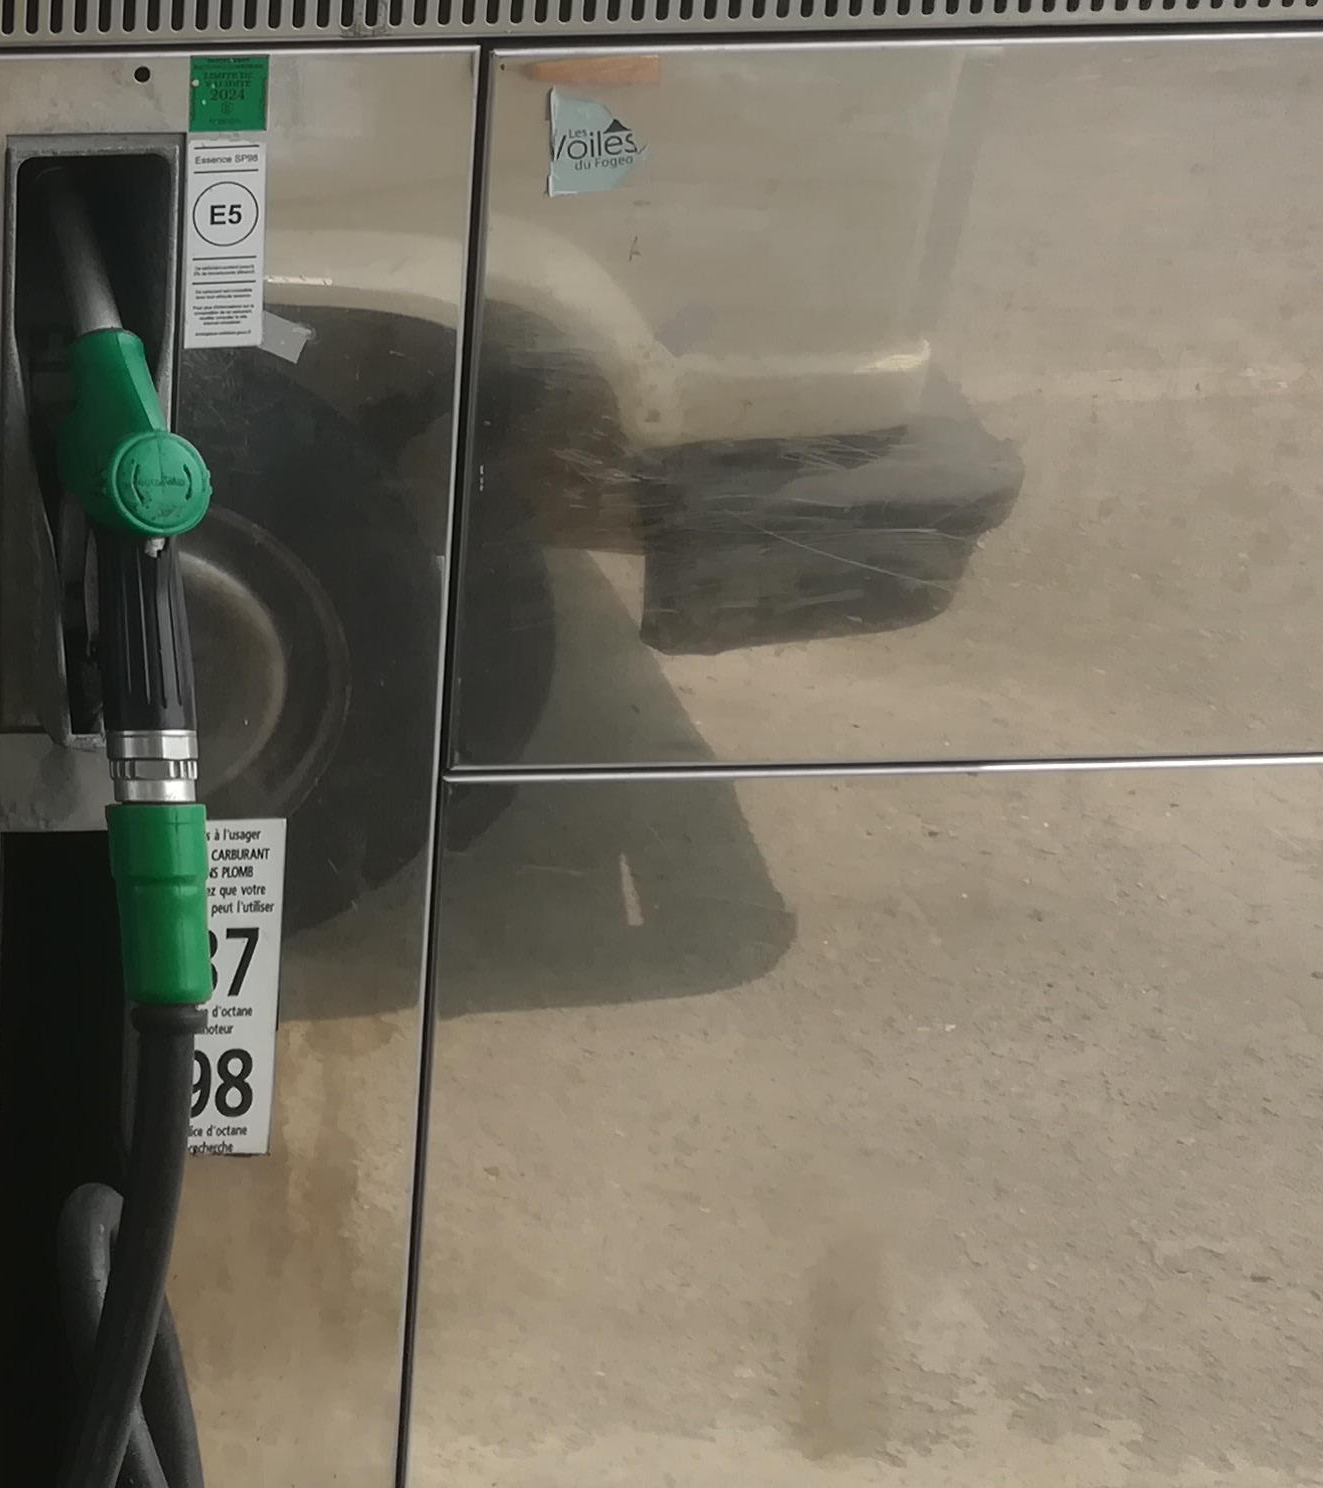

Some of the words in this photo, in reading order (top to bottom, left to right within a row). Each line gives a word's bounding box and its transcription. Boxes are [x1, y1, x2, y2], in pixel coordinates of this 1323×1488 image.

[210, 88, 245, 101] 2024
[568, 128, 588, 139] Les
[194, 156, 232, 166] Essence
[234, 154, 259, 164] SP98
[574, 160, 591, 171] du
[210, 204, 242, 226] E5
[214, 828, 220, 841] à
[223, 828, 262, 843] l'usager
[211, 847, 271, 862] CARBURANT
[221, 866, 254, 879] PLOMB
[219, 885, 238, 899] que
[241, 884, 266, 896] votre
[211, 903, 233, 918] peut
[236, 900, 275, 915] l'utiliser
[212, 1004, 253, 1018] d'octane
[189, 1048, 254, 1118] 98
[206, 1124, 248, 1137] d'octane
